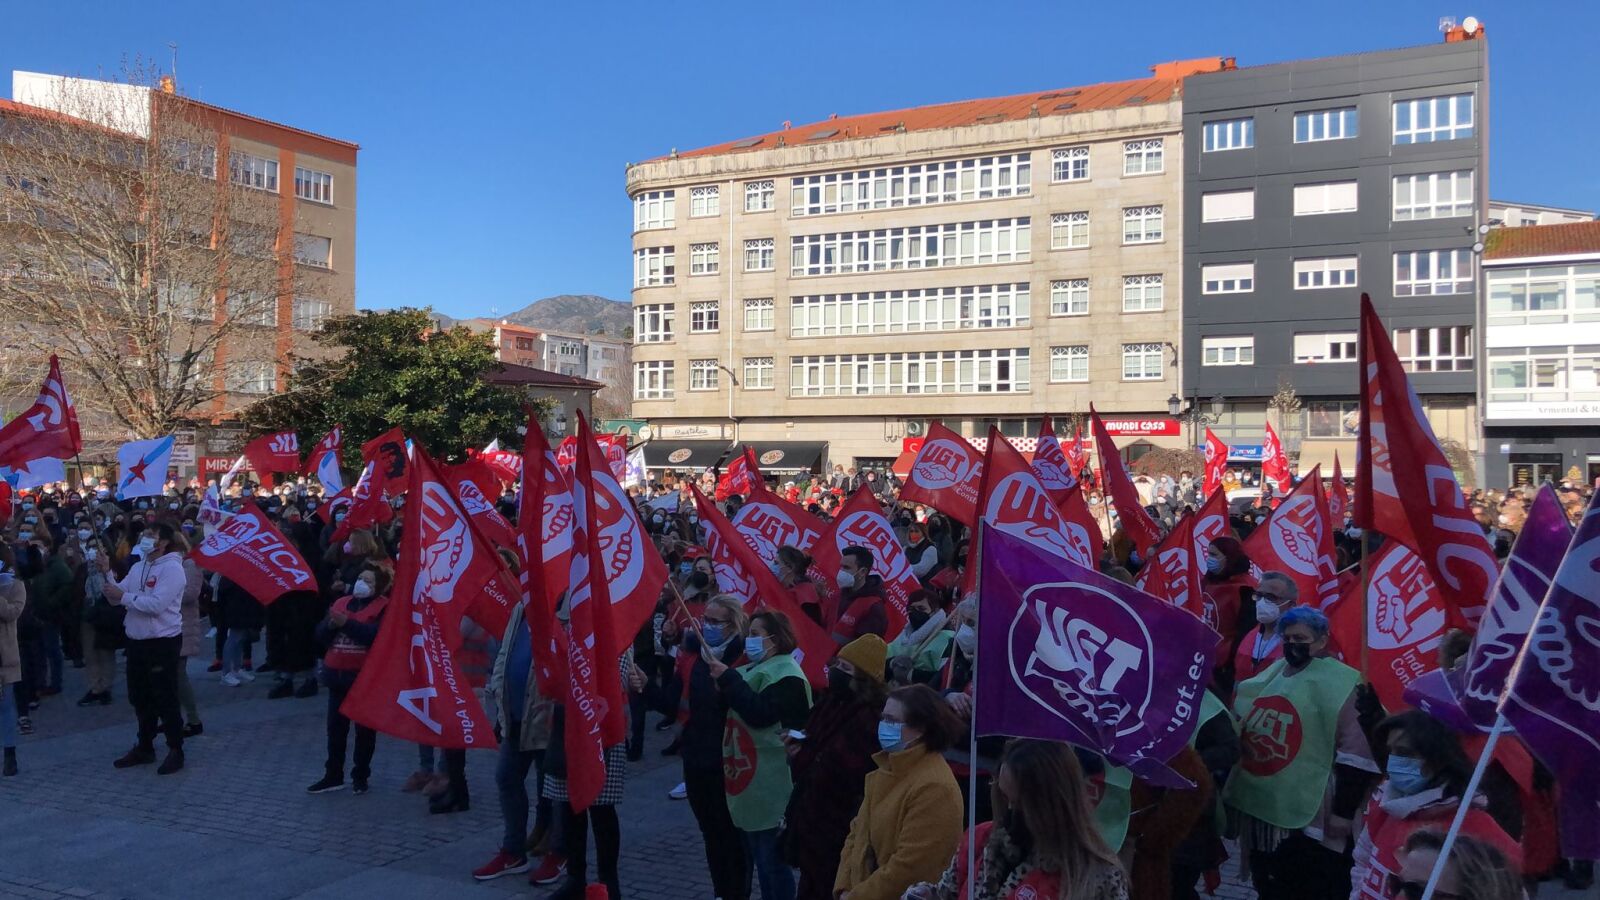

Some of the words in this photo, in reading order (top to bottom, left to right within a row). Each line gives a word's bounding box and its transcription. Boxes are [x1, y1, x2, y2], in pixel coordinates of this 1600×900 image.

[921, 443, 965, 473] UGT
[742, 505, 795, 551] UGT
[850, 514, 900, 562] UGT
[243, 531, 310, 585] FICA
[1035, 599, 1143, 692] UGT
